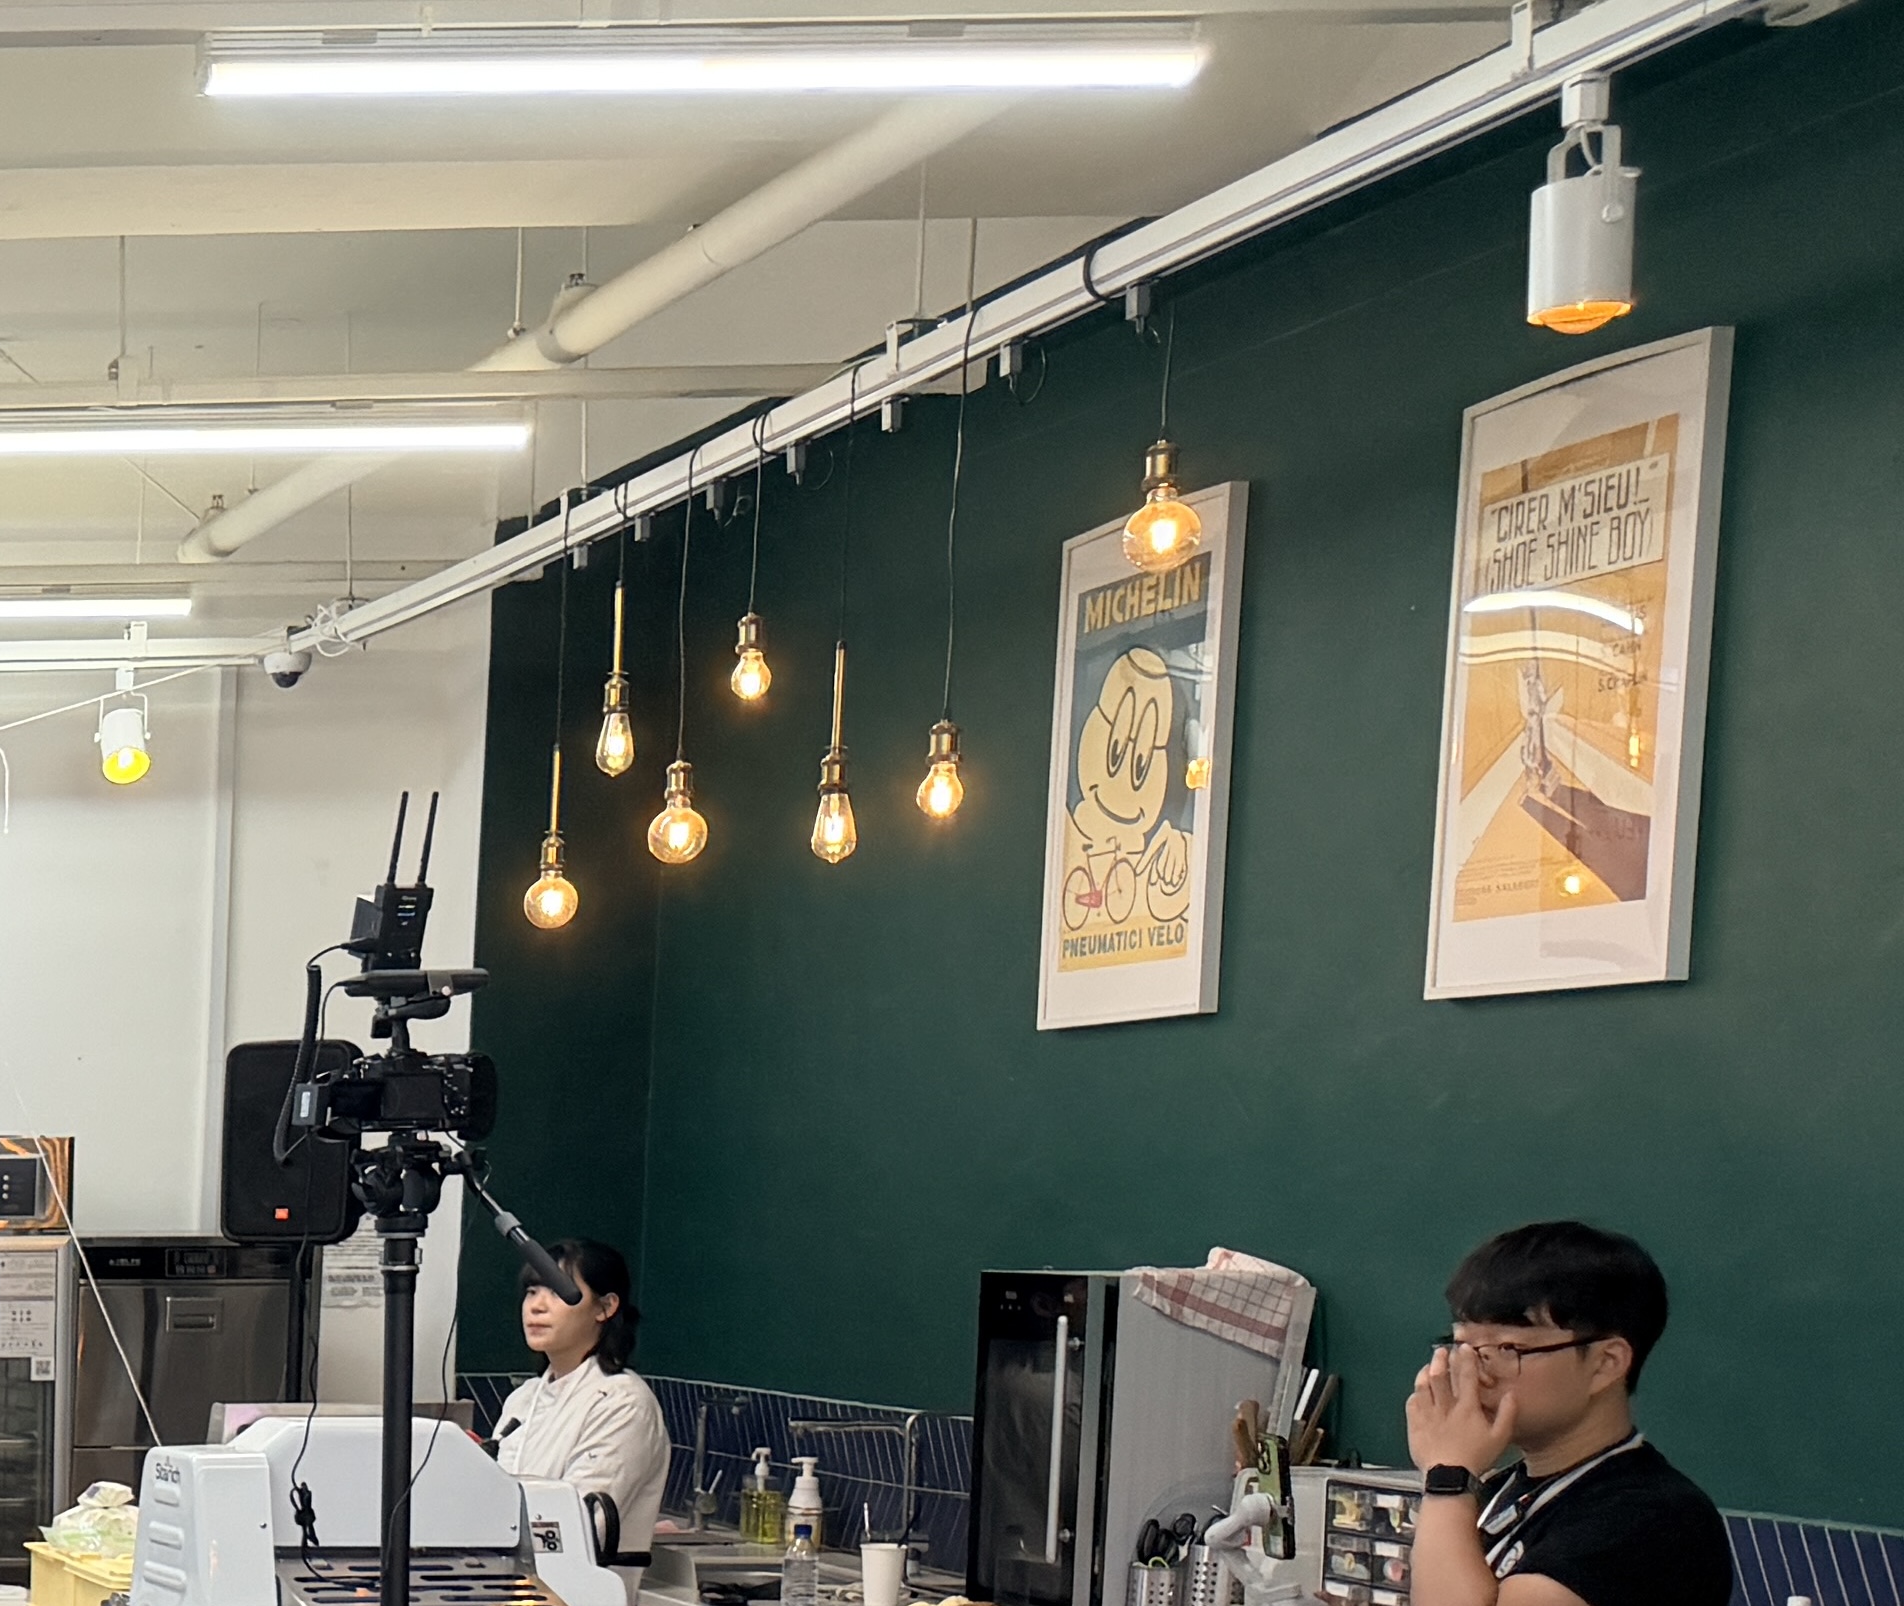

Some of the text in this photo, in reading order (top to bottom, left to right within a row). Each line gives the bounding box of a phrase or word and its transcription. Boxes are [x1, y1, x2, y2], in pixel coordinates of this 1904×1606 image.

[1544, 521, 1600, 581] SHINE
[1084, 561, 1202, 634] MICHELIN
[1061, 922, 1185, 960] PNEUMATICI VELO
